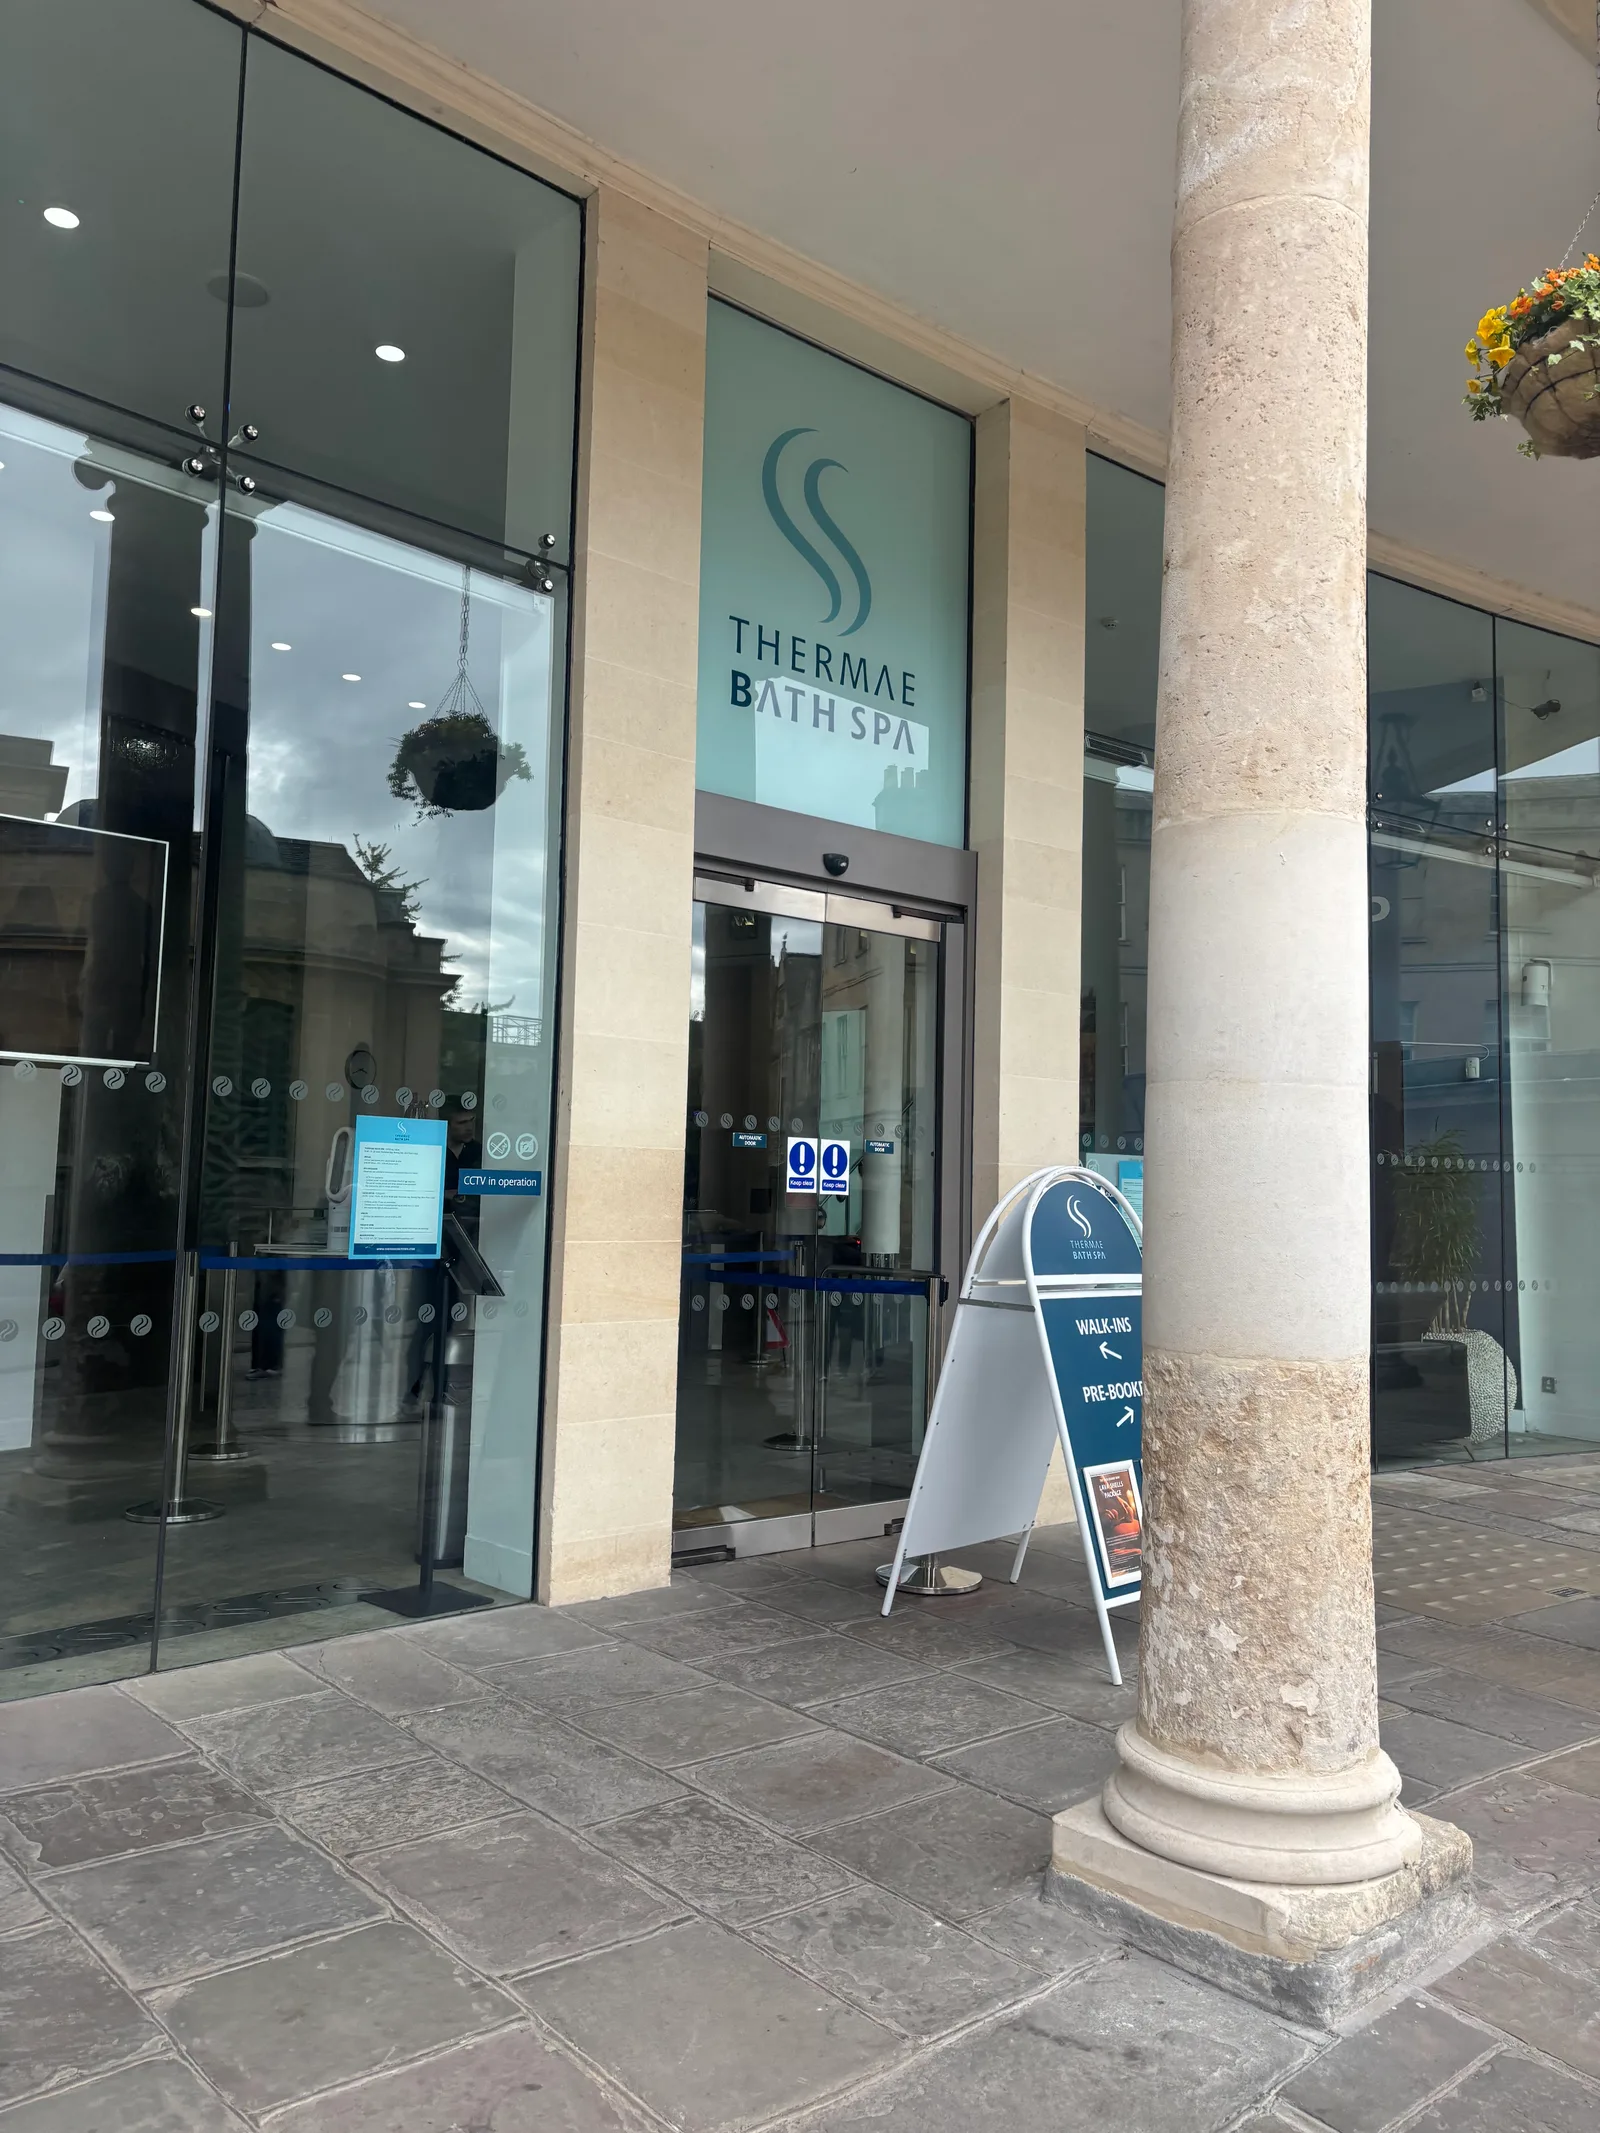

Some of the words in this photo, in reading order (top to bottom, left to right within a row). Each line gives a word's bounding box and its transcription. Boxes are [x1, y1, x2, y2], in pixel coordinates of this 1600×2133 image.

[729, 615, 915, 707] THERMAE
[730, 669, 835, 733] BATH
[850, 706, 915, 755] SPA
[463, 1175, 486, 1185] CCTV
[488, 1176, 496, 1186] in
[498, 1177, 537, 1188] operation
[790, 1179, 802, 1187] Keep
[1070, 1240, 1104, 1249] THERMAE
[1072, 1251, 1092, 1260] BATH
[1093, 1250, 1107, 1260] SPA
[1075, 1317, 1132, 1336] WALK-INS
